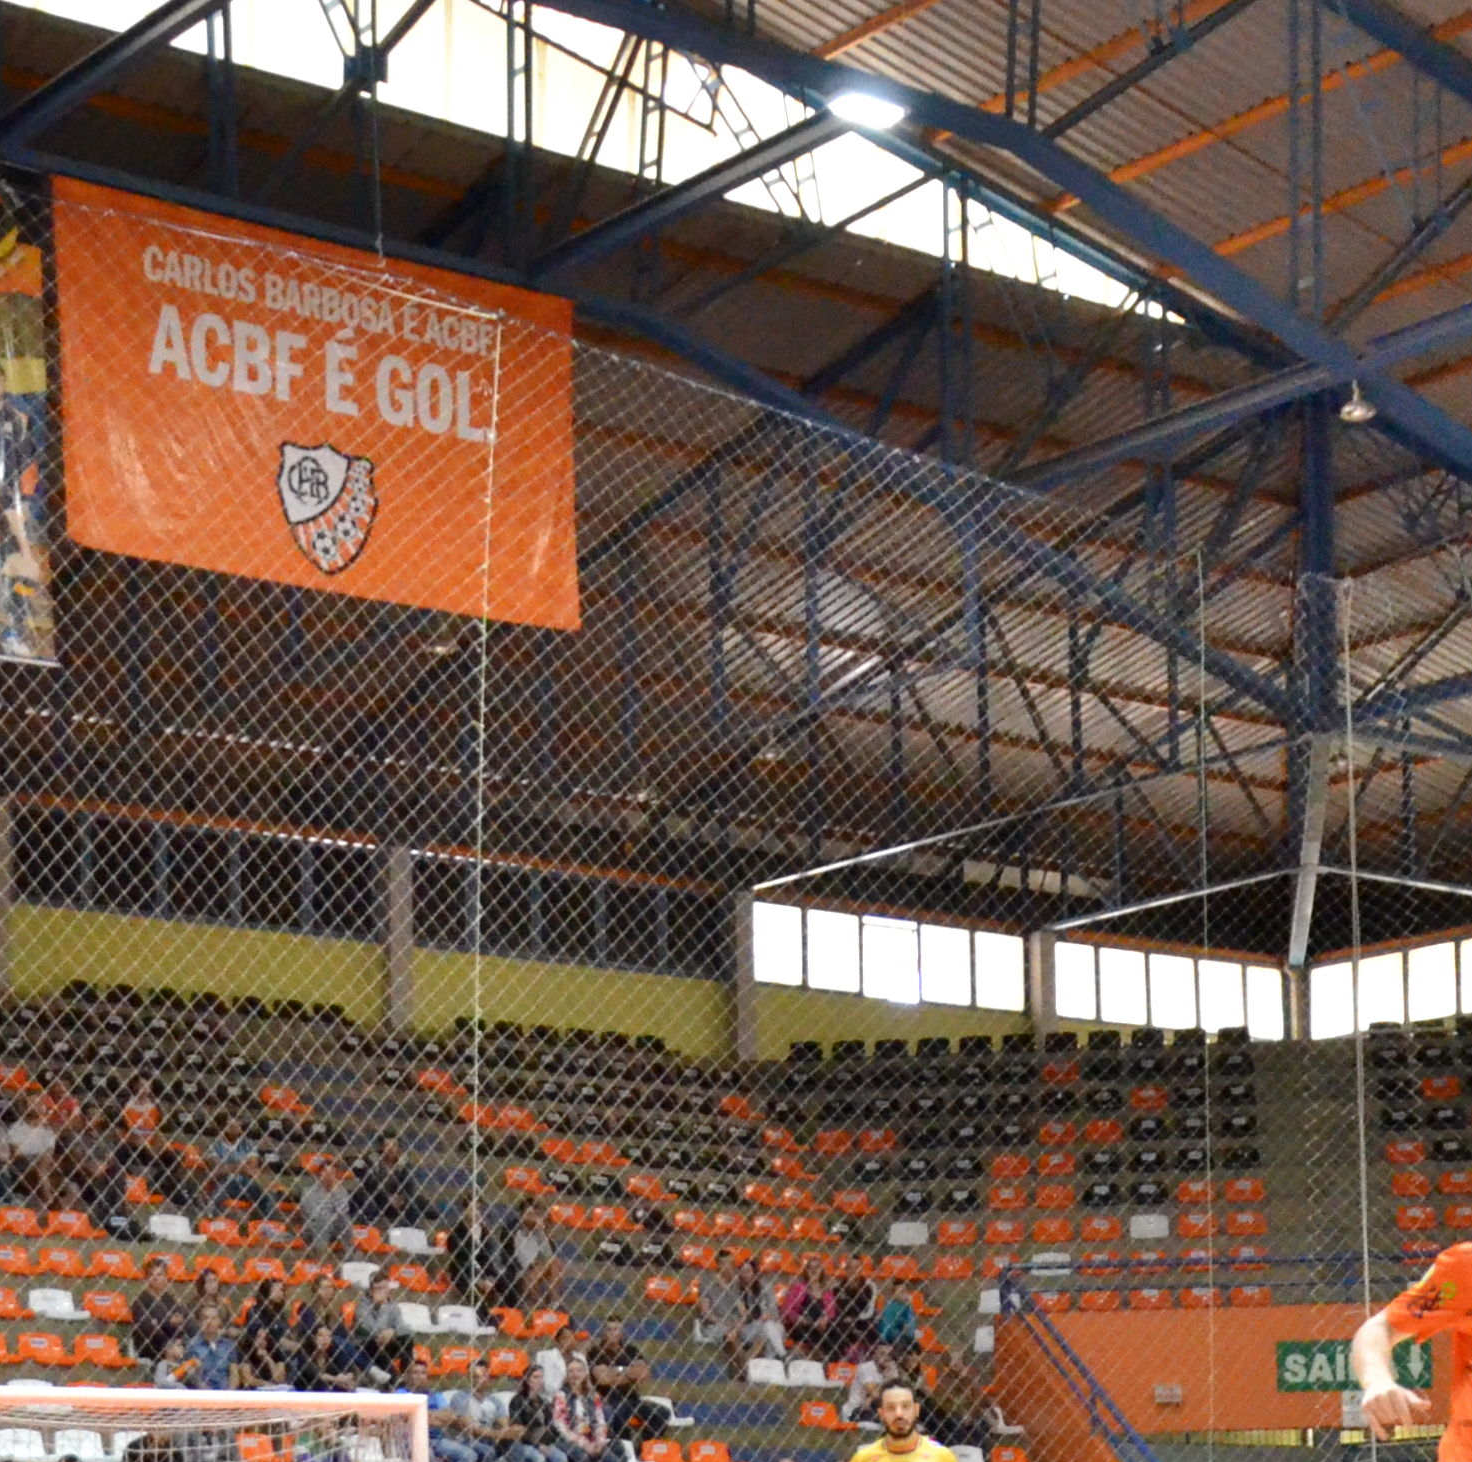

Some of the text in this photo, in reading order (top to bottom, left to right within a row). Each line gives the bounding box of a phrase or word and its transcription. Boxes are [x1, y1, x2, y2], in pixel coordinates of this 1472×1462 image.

[142, 245, 257, 304] CARLOS
[263, 272, 395, 336] BARBOSA
[148, 304, 308, 401] ACBF
[325, 328, 359, 417] É
